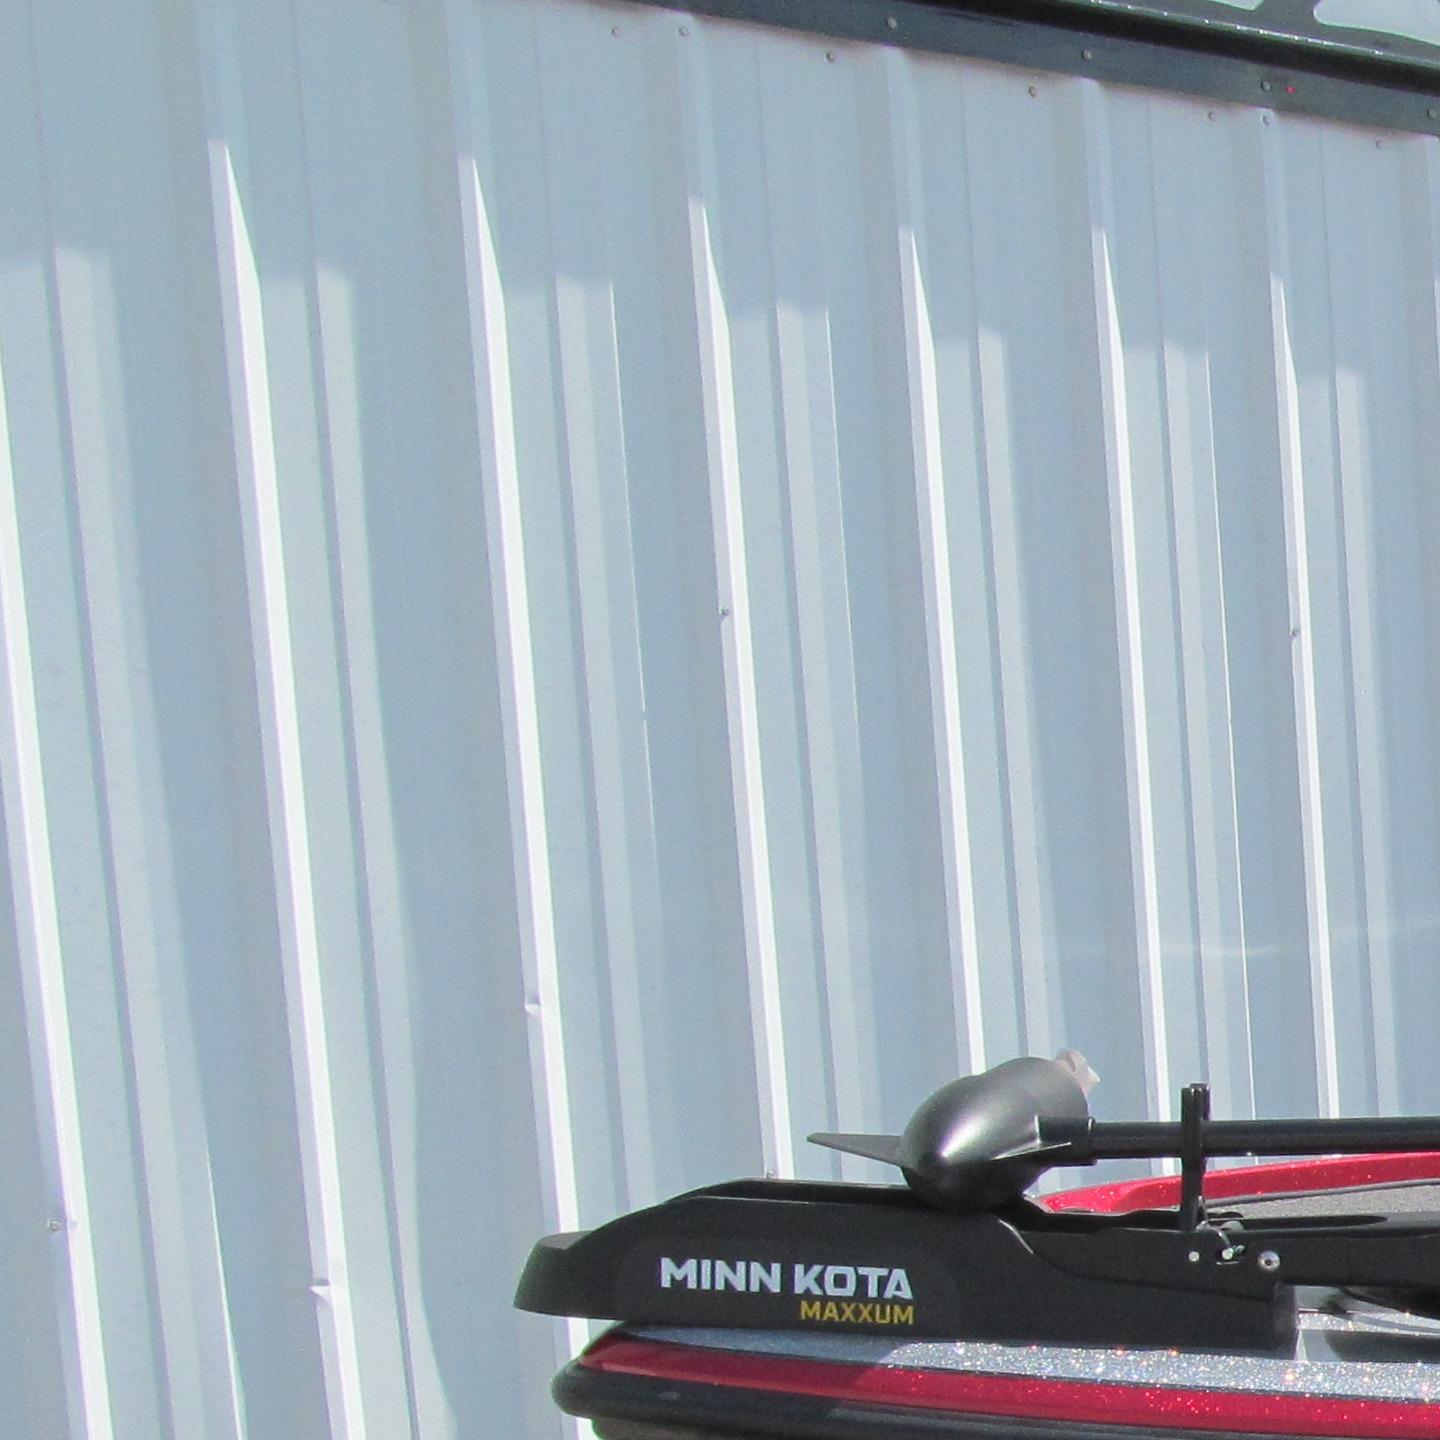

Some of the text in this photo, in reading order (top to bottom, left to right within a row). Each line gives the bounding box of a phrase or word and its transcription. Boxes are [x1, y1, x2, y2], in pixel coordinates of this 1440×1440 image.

[660, 1257, 914, 1299] MINN KOTA
[800, 1300, 915, 1325] MAXXUM
